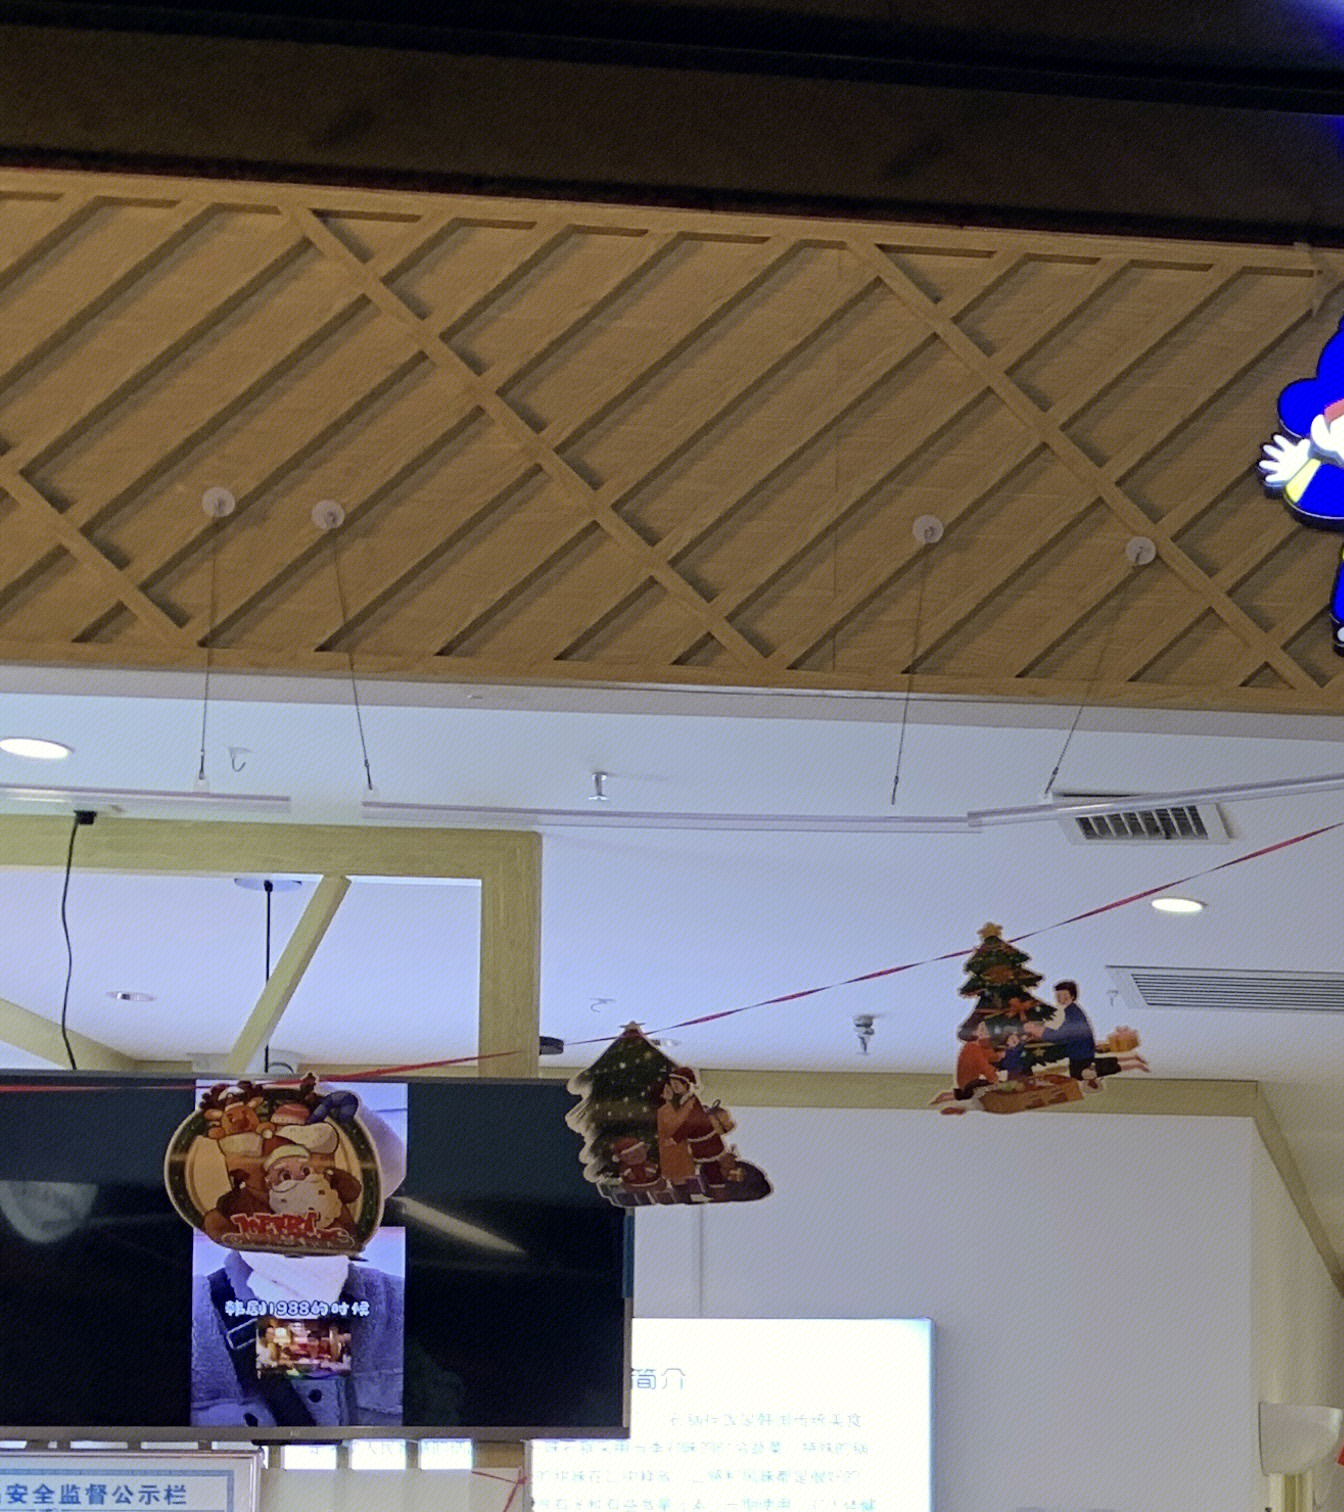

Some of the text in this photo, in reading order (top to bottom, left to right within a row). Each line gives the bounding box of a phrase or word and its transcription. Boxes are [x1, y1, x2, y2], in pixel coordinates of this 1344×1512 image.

[630, 1367, 687, 1391] 简介
[0, 1483, 187, 1506] 安全监督公示栏
